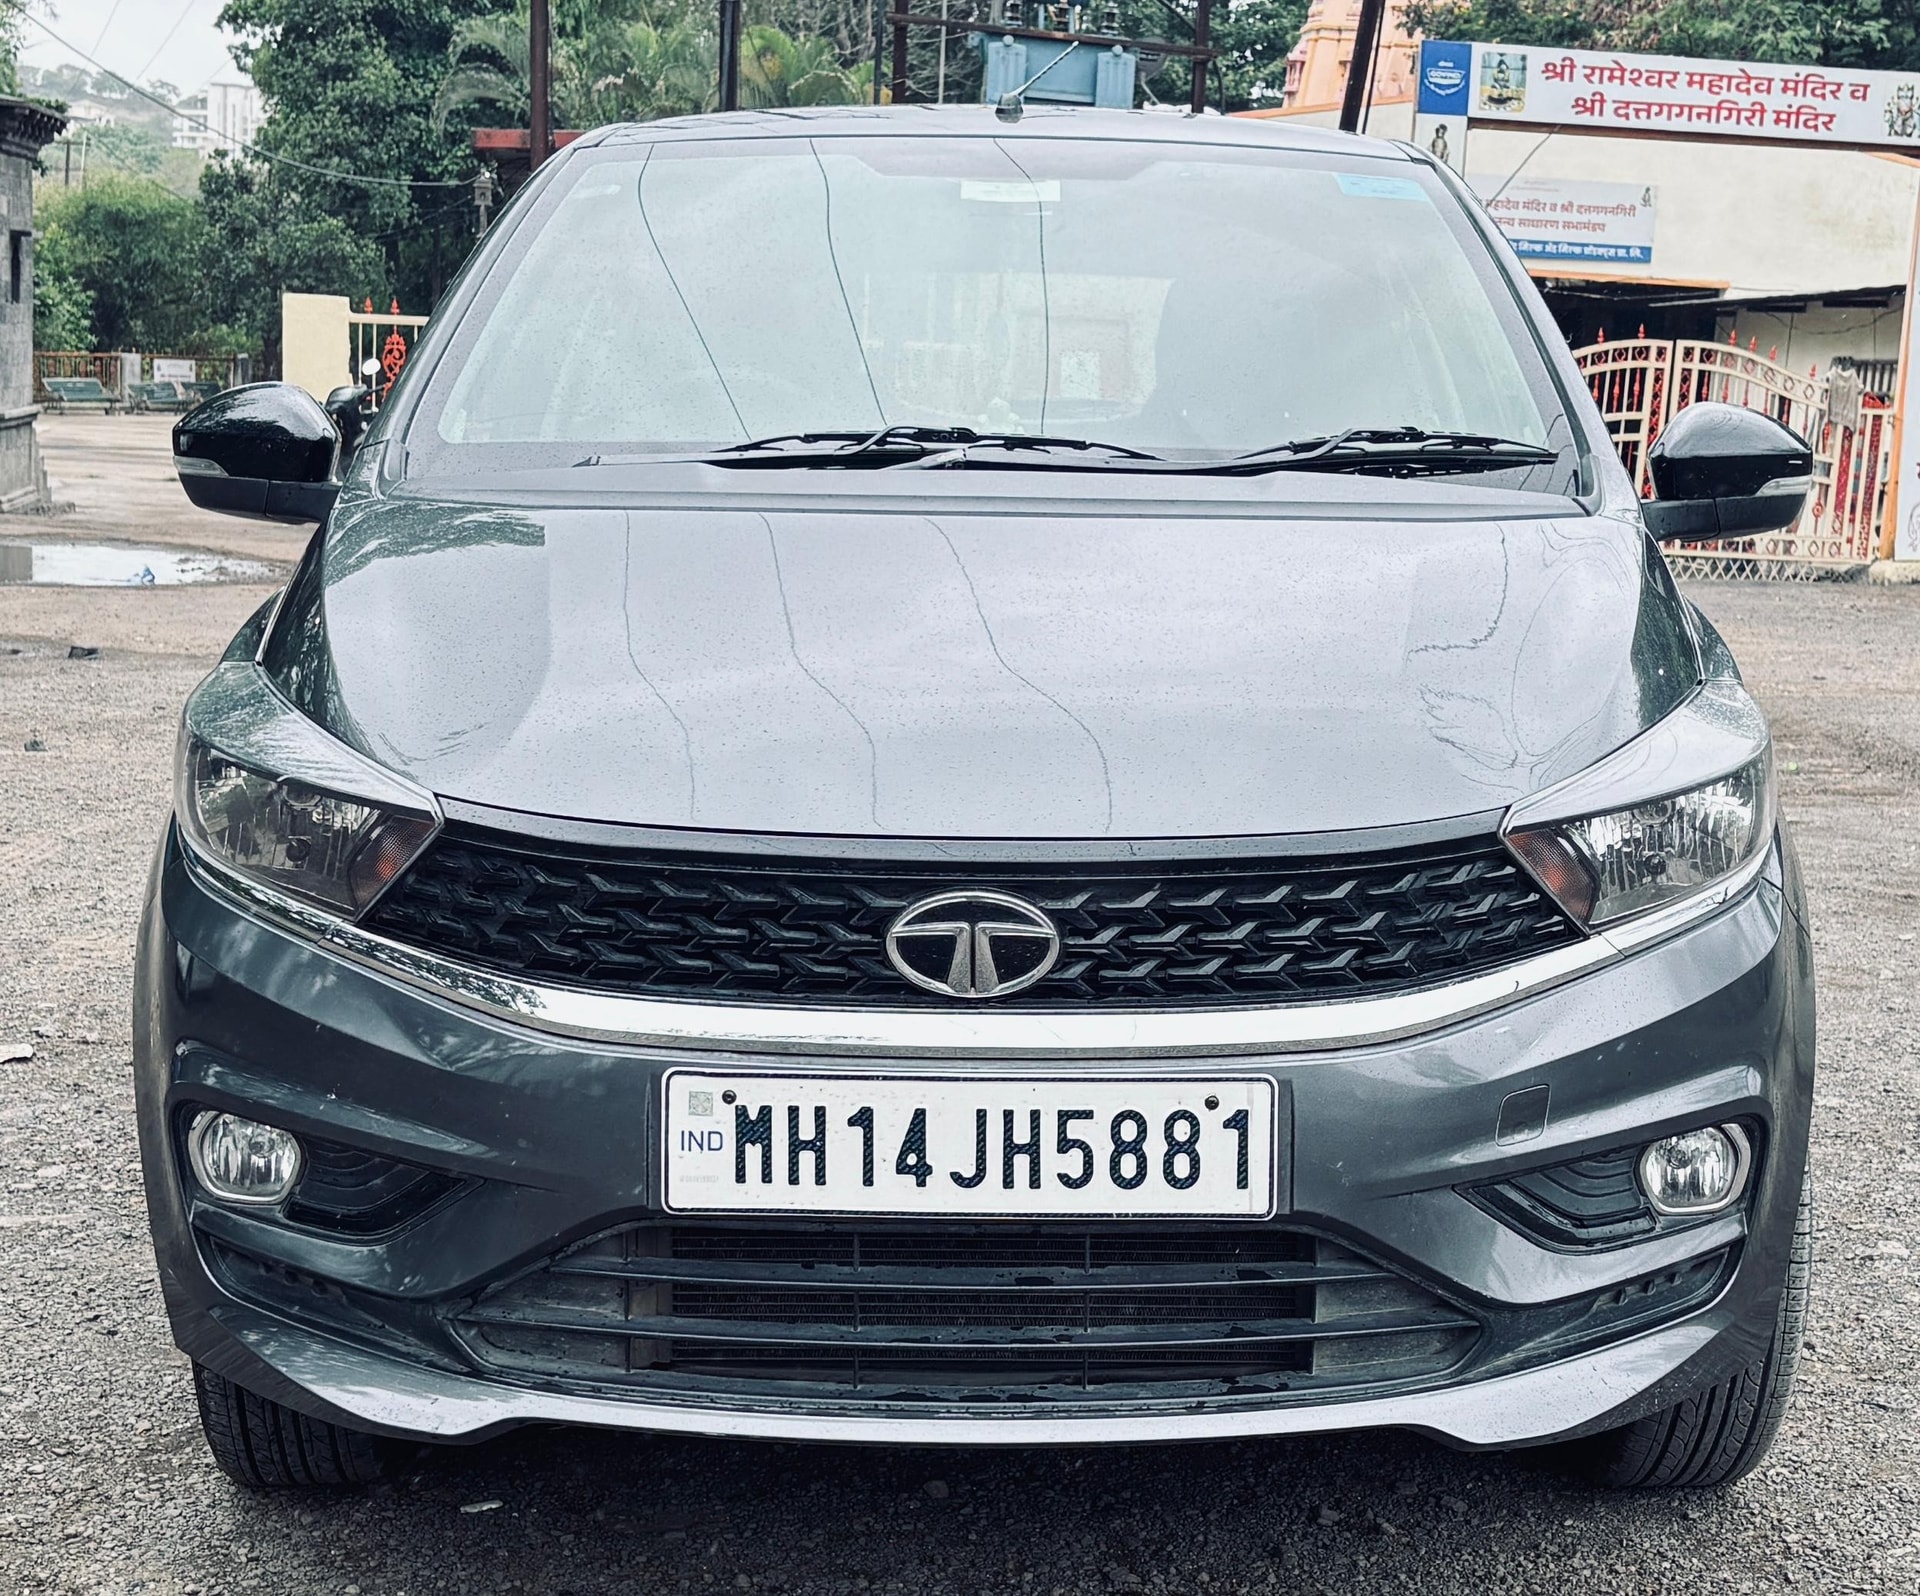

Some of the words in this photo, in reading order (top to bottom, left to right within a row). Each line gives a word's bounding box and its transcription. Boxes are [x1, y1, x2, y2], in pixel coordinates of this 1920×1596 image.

[1541, 56, 1577, 83] श्री
[1582, 59, 1680, 89] रामेश्वर
[1685, 68, 1775, 96] महादेव
[1780, 72, 1844, 101] मंदिर
[1849, 83, 1871, 102] व
[1571, 91, 1607, 117] श्री
[1612, 99, 1767, 127] दत्तगगनगिरी
[1773, 103, 1837, 132] मंदिर
[1522, 199, 1547, 213] मंदिर
[1550, 202, 1558, 212] व
[1560, 200, 1574, 214] श्री
[681, 1130, 723, 1152] IND
